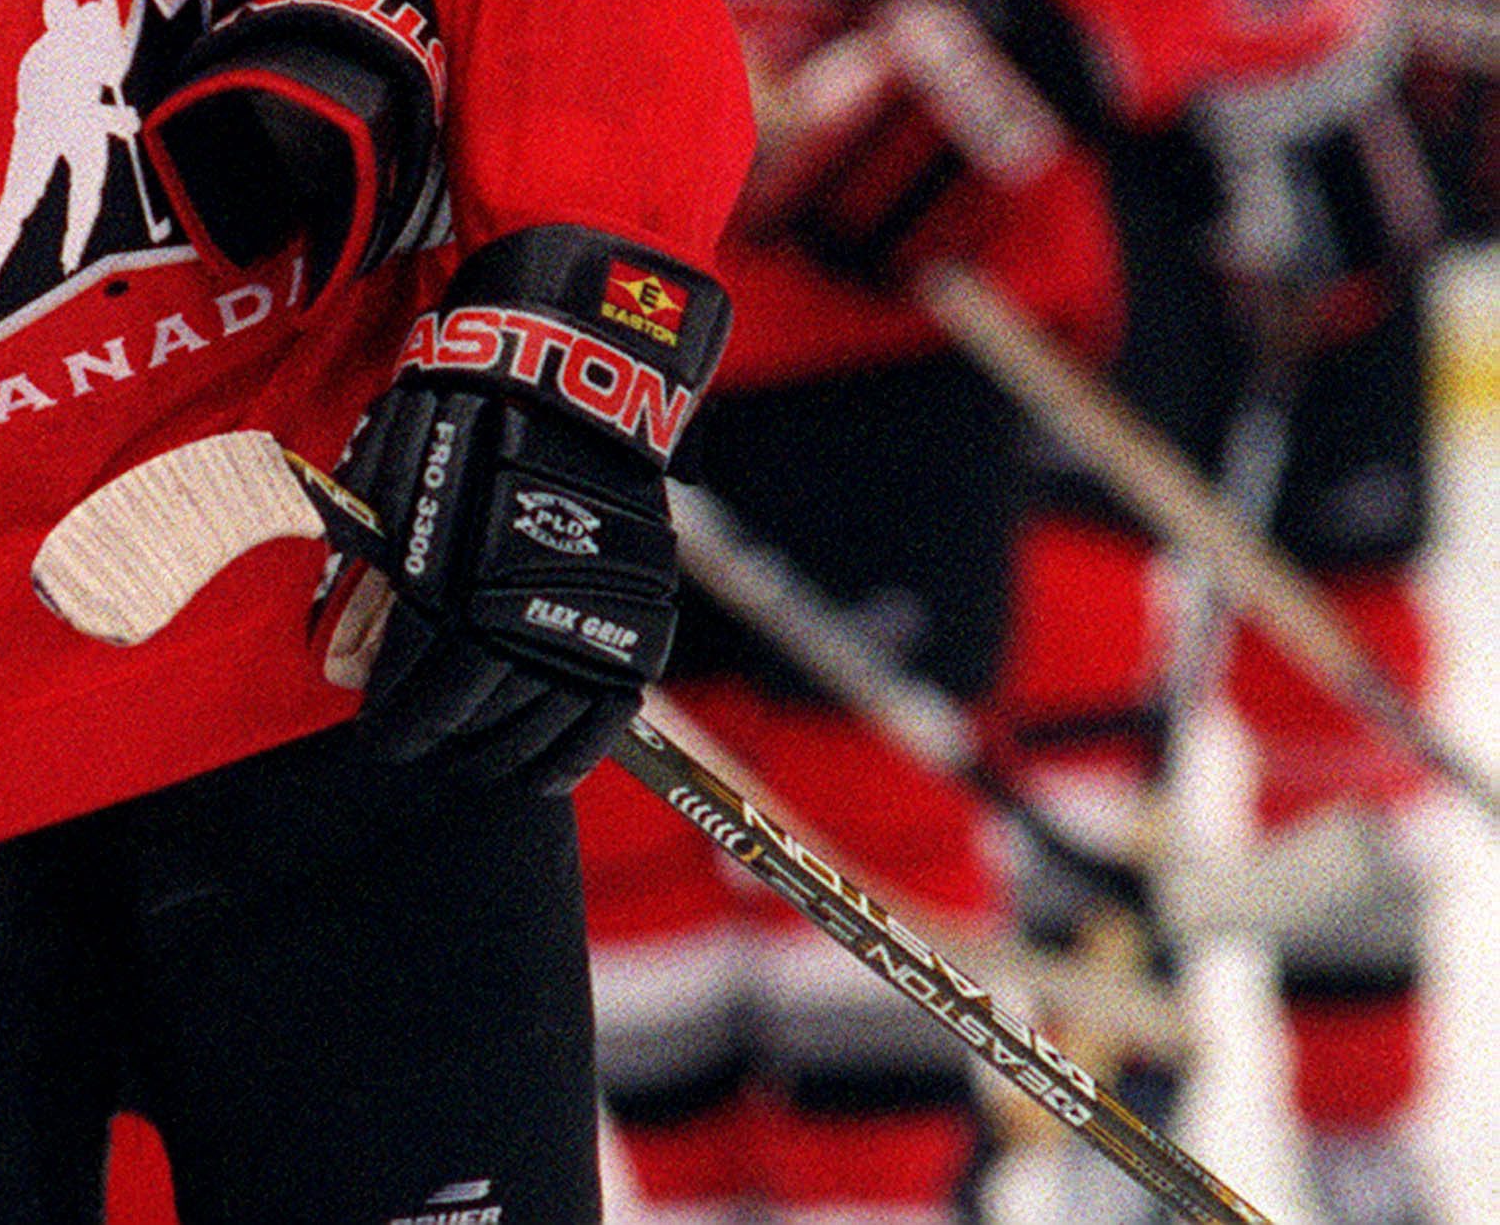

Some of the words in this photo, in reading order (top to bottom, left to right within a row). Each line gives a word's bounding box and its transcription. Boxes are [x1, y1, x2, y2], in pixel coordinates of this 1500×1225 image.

[601, 300, 679, 348] EASTON
[391, 305, 694, 460] ASTON
[405, 496, 439, 575] 3300
[525, 597, 581, 631] FLEX
[581, 616, 639, 648] GRIP
[865, 941, 1051, 1096] EASTON
